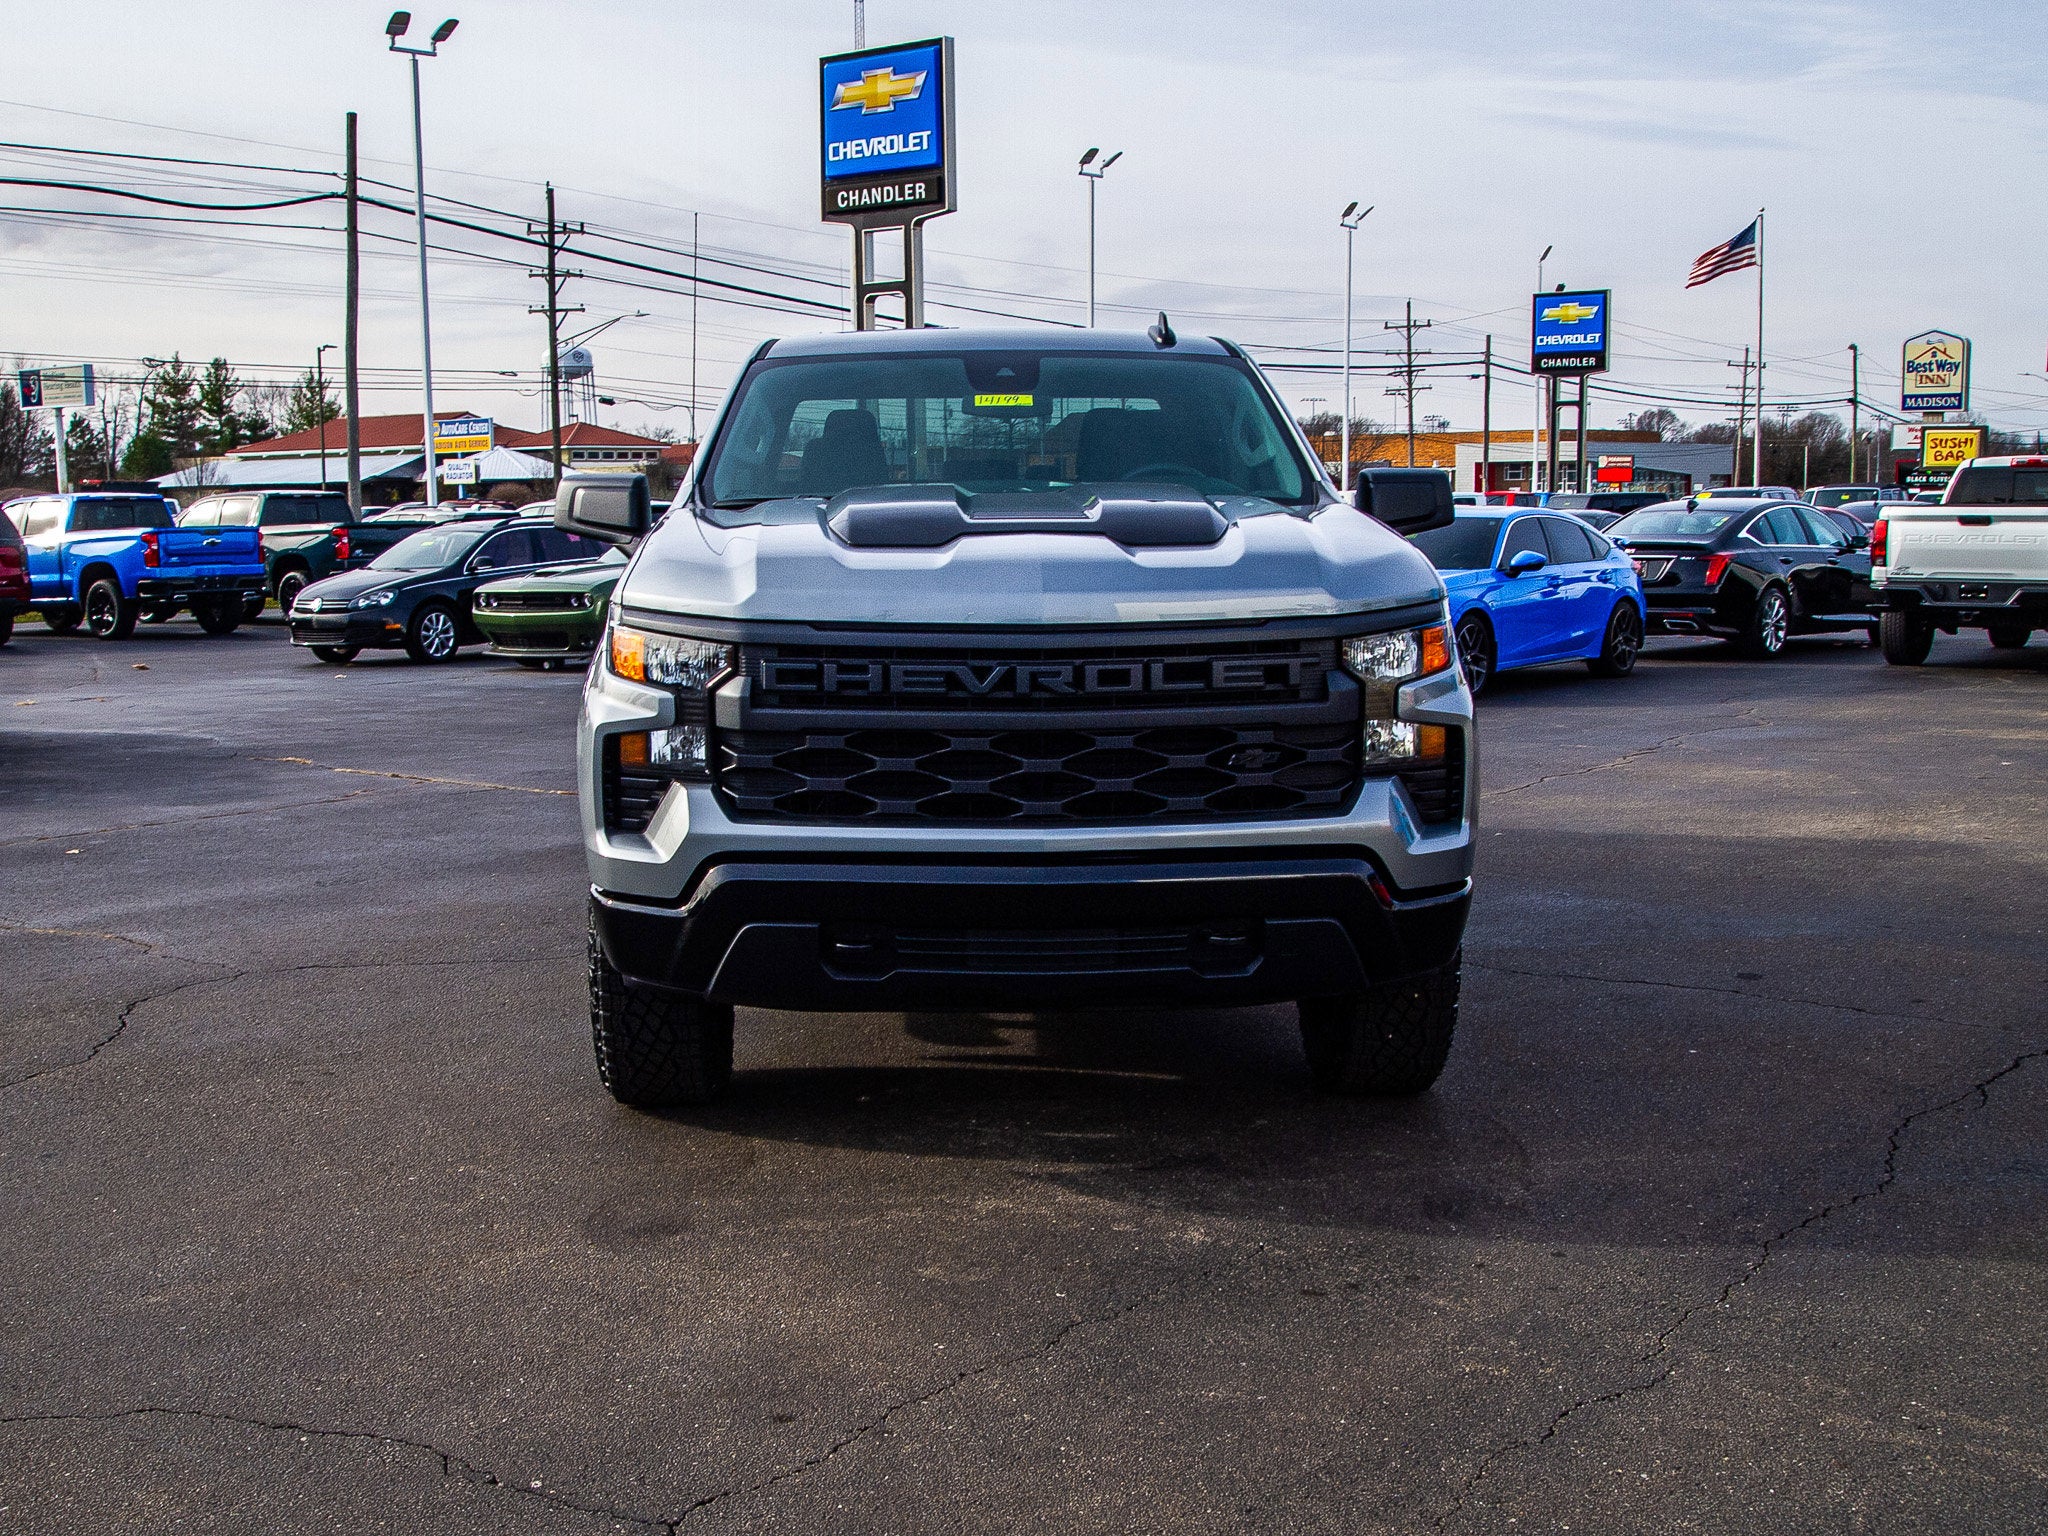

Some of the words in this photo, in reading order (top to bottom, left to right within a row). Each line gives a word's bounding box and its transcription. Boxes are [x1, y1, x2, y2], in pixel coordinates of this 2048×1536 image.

[828, 130, 932, 161] CHEVROLET
[837, 182, 926, 208] CHANDLER
[1536, 333, 1602, 346] CHEVROLET
[1541, 357, 1596, 368] CHANDLER
[1906, 359, 1934, 374] Best
[1934, 359, 1962, 377] Way
[1918, 373, 1948, 385] INN
[1904, 396, 1960, 408] MADISON
[1929, 437, 1974, 449] SUSHI
[1933, 450, 1966, 462] BAR
[447, 462, 471, 471] QUALITY
[445, 471, 473, 480] RADIATOR
[1903, 534, 2046, 545] CHEVROLET
[760, 652, 1322, 695] CHEVROLET
